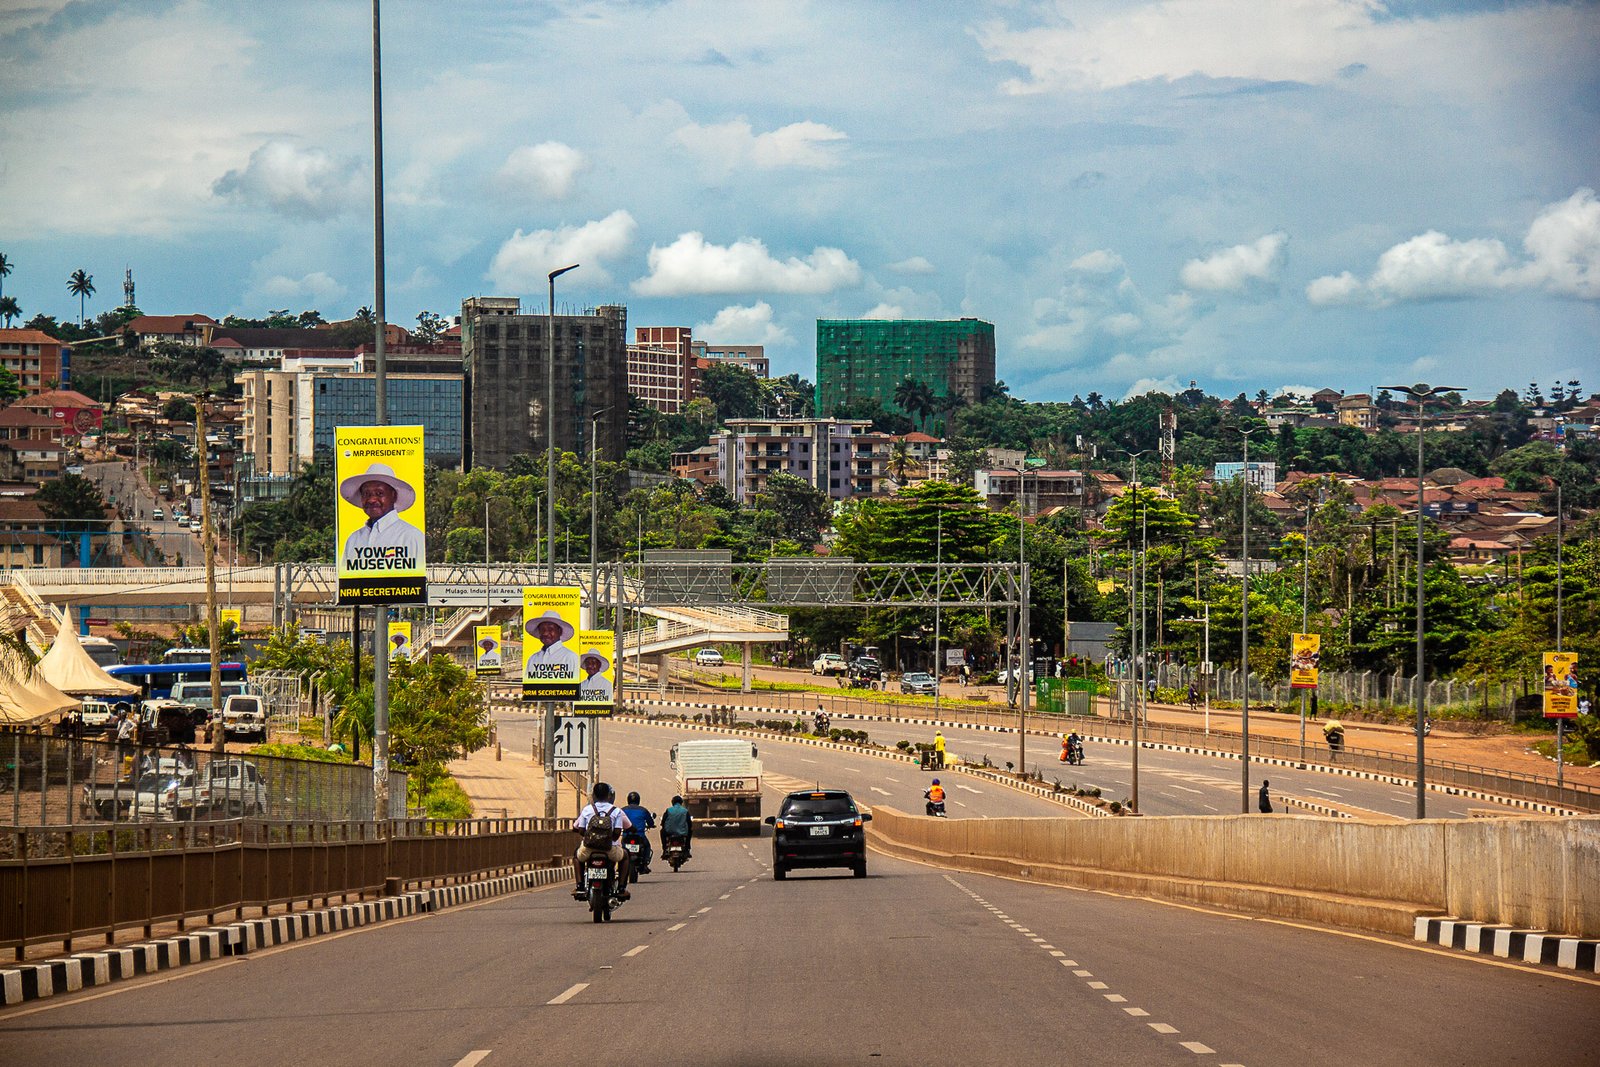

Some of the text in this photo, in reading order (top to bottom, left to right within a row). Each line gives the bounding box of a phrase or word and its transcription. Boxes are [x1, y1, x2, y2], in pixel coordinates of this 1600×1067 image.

[337, 437, 421, 446] CONGRATULATIONS!
[354, 546, 408, 558] YOWERI
[346, 557, 416, 571] MUSEVENI
[340, 587, 421, 597] NRM SECRETARIAT
[528, 671, 574, 679] MUSEVENI
[700, 780, 744, 790] EICHER
